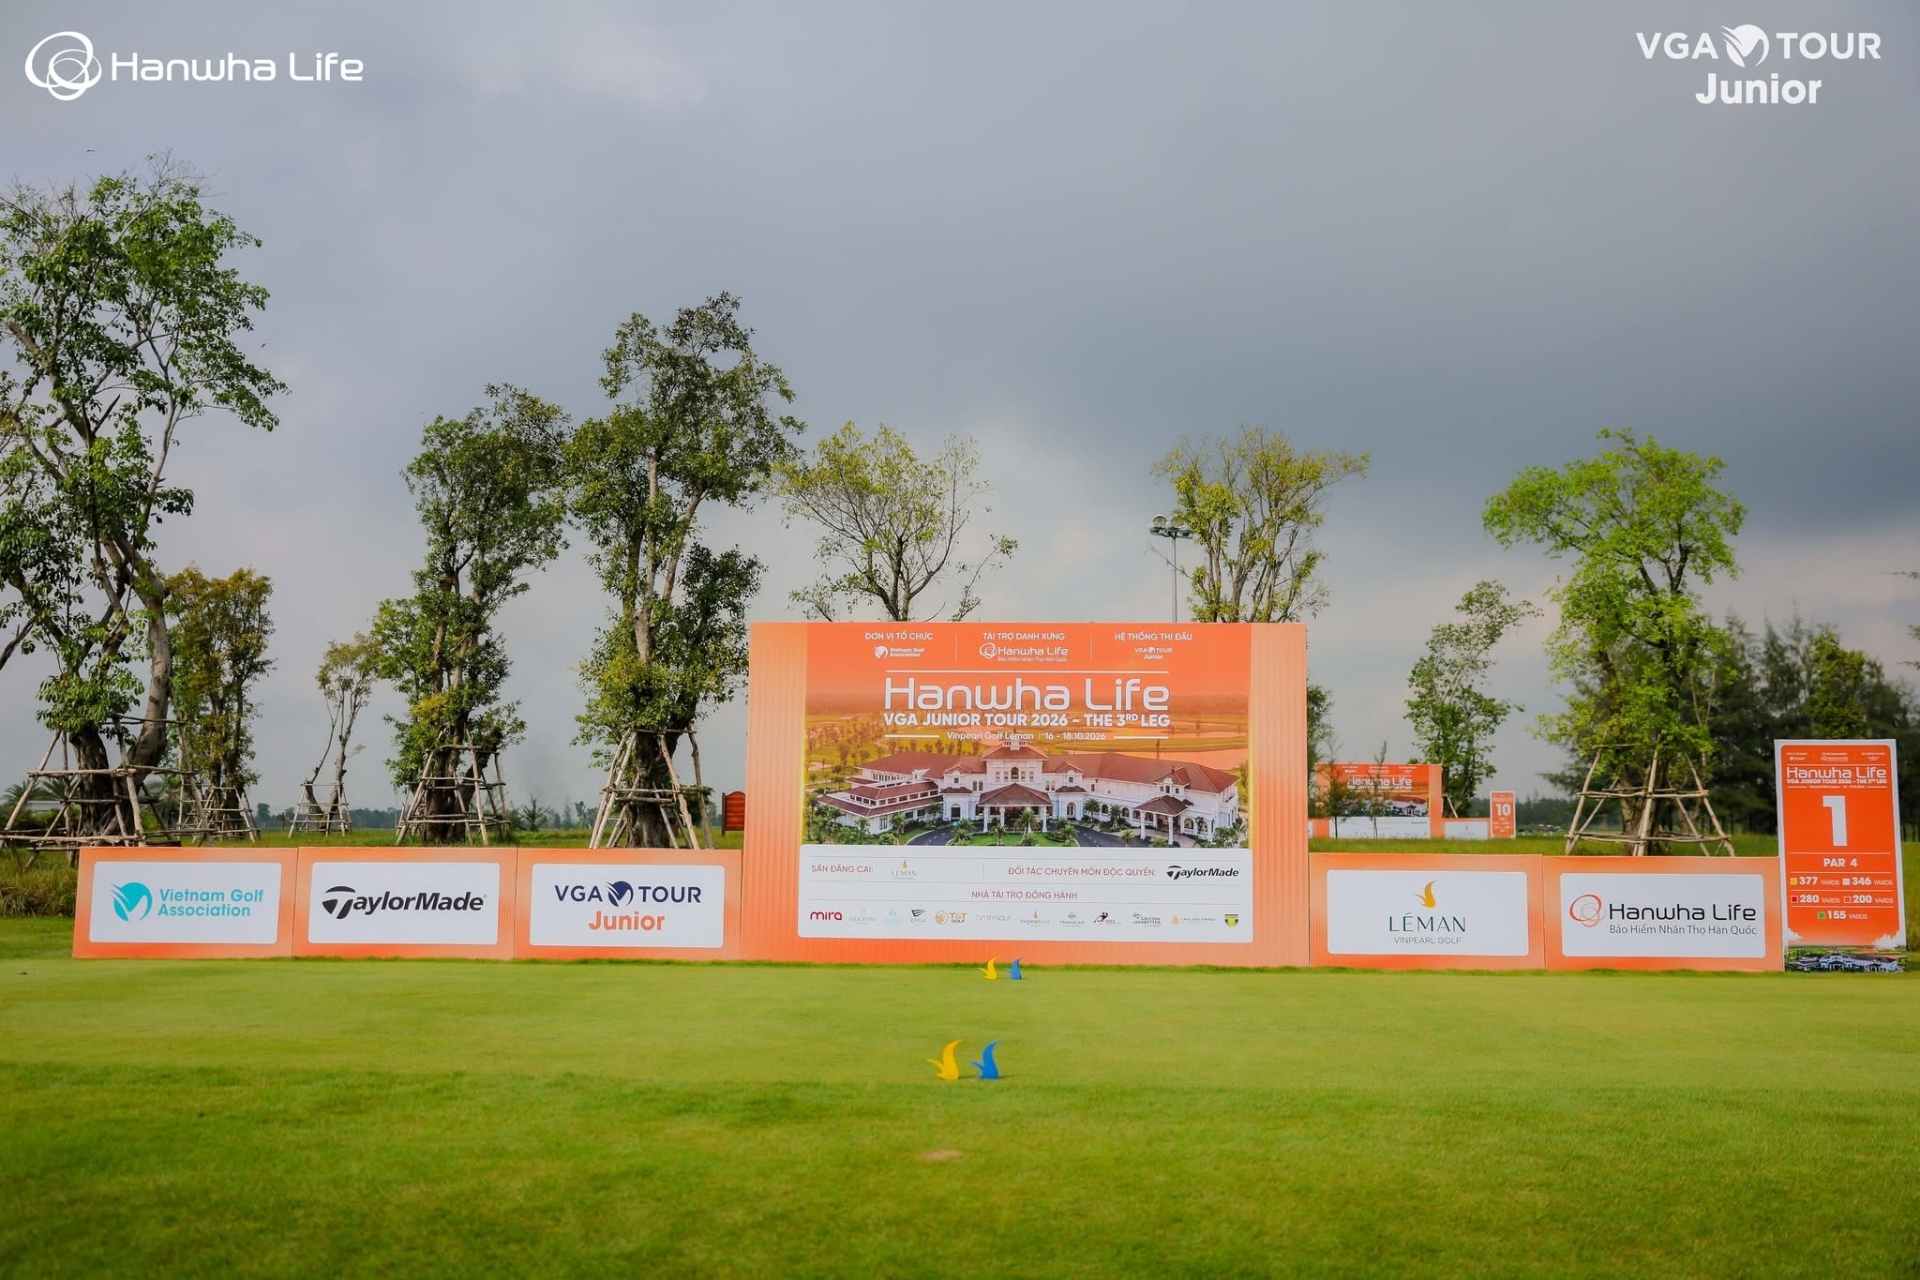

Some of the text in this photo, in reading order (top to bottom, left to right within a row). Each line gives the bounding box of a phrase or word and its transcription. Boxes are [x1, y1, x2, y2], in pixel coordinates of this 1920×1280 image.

[865, 630, 934, 642] ĐƠN VỊ TỔ CHỨC
[982, 631, 1065, 642] TÀI TRỢ DANH XƯNG
[1114, 630, 1193, 642] HỆ THỐNG THI ĐẤU
[998, 647, 1069, 656] Hanwha Life
[885, 677, 1170, 711] Hanwha Life
[883, 712, 918, 726] VGA
[922, 713, 981, 727] JUNIOR
[984, 713, 1028, 727] TOUR
[1031, 713, 1069, 727] 2026
[1084, 713, 1112, 727] THE
[1140, 714, 1171, 728] LEG
[946, 731, 983, 742] Vinpearl
[984, 731, 1004, 740] Golf
[1044, 732, 1054, 740] 16
[1062, 732, 1106, 740] 18.10.2026
[1786, 766, 1887, 779] Hanwha Life
[1391, 776, 1412, 787] Life
[1496, 803, 1511, 817] 10
[1822, 795, 1848, 847] 1
[811, 863, 874, 873] SÂN ĐĂNG CAI:
[1823, 858, 1858, 867] PAR 4
[1008, 865, 1024, 875] ĐỐI
[1025, 865, 1043, 876] TÁC
[1044, 866, 1079, 876] CHUYÊN
[1080, 866, 1101, 876] MÔN
[1103, 866, 1124, 878] ĐỘC
[1166, 865, 1240, 880] TaylorMade
[1799, 876, 1818, 885] 377
[1852, 877, 1872, 885] 346
[159, 887, 264, 903] Vietnam Golf
[554, 884, 702, 904] VGA TOUR
[971, 889, 1078, 900] NHÀ TÀI TRỢ ĐỒNG HÀNH
[1800, 894, 1819, 903] 280
[1852, 895, 1873, 904] 200
[321, 885, 485, 920] TaylorMade
[157, 902, 251, 917] Association
[1609, 903, 1757, 921] Hanwha Life
[1827, 910, 1846, 920] 155
[588, 909, 666, 931] Junior
[809, 911, 843, 921] mira
[950, 912, 967, 920] T&T
[1388, 911, 1467, 933] LÉMAN
[1609, 923, 1757, 937] Bảo Hiểm Nhân Thọ Hàn Quốc
[1394, 936, 1462, 945] VINPEARL GOLF
